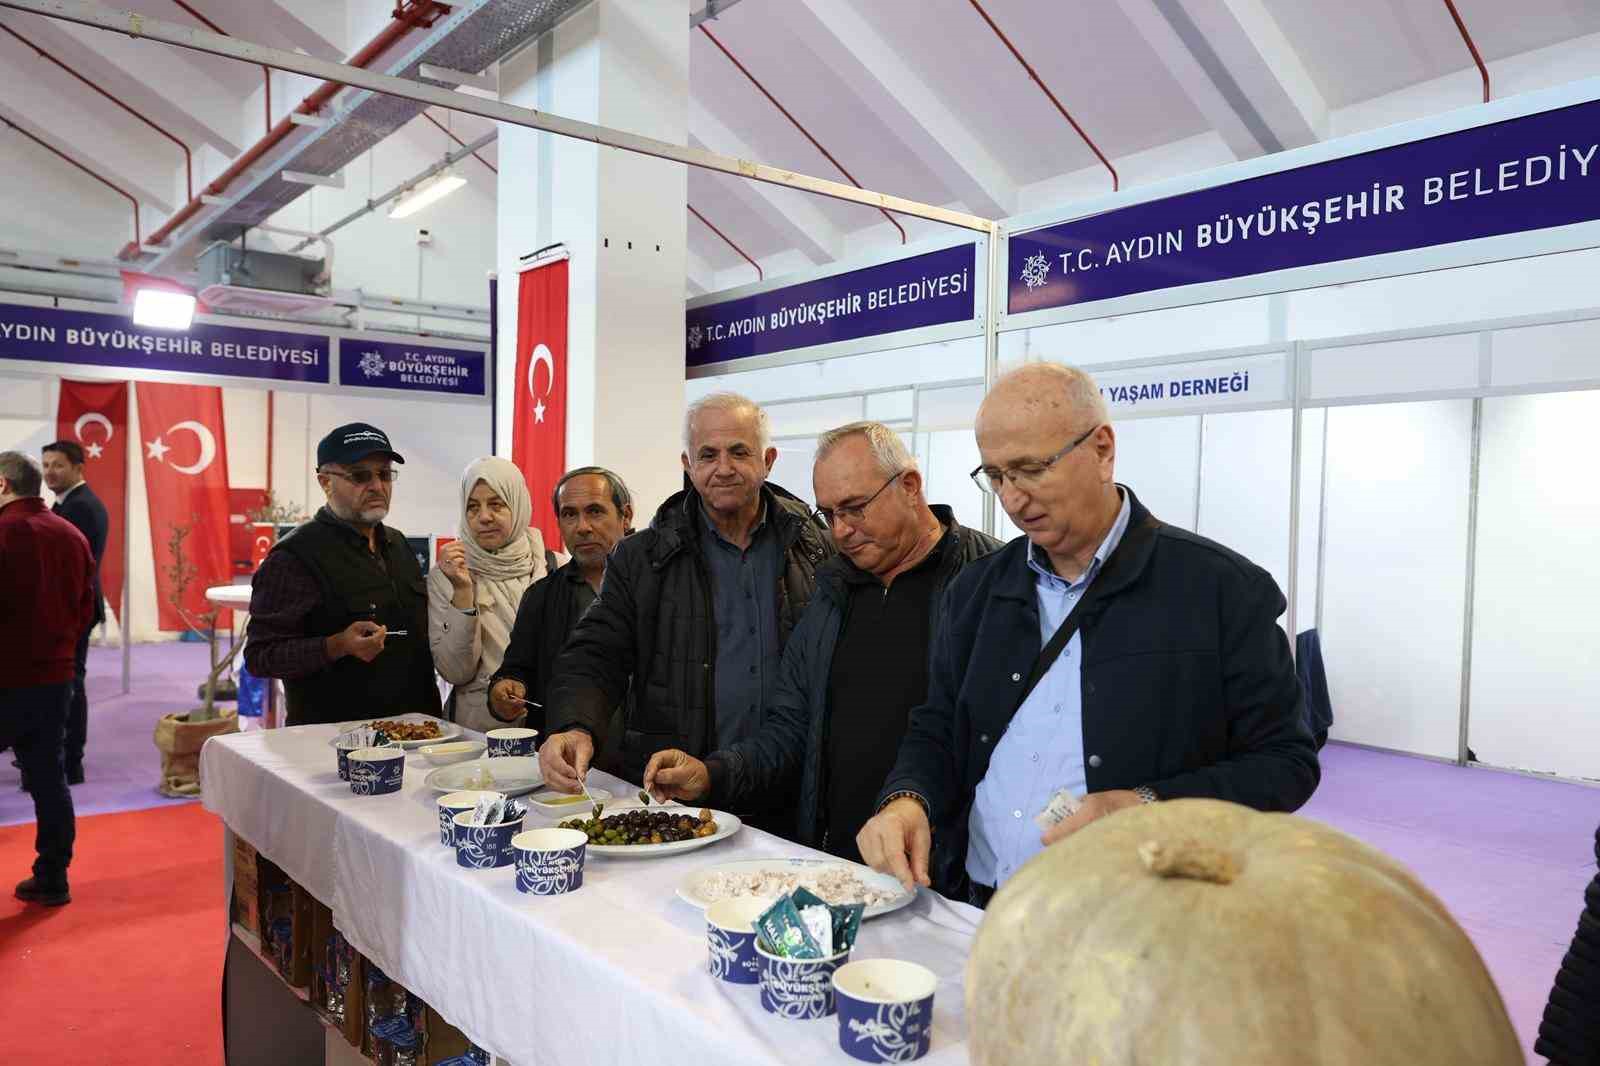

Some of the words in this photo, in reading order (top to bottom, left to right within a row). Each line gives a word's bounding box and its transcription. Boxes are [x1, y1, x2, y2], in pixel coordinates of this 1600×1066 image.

[1059, 248, 1099, 275] T.C.
[1105, 229, 1183, 266] AYDIN
[1197, 182, 1405, 248] BÜYÜKŞEHİR
[1423, 144, 1599, 206] BELEDİY
[705, 324, 727, 342] T.C.
[728, 315, 766, 338] AYDIN
[770, 292, 862, 331] BÜYÜKŞEHİR
[867, 267, 968, 310] BELEDİYESİ
[0, 322, 56, 342] YDIN
[66, 327, 203, 355] BÜYÜKŞEHİR
[211, 341, 319, 366] BELEDİYESİ
[425, 354, 456, 365] AYDIN
[389, 359, 469, 377] BÜYÜKŞEHİR
[400, 373, 459, 387] BELEDİYESİ
[1109, 382, 1164, 405] YAŞAM
[1169, 371, 1249, 398] DERNEĞİ
